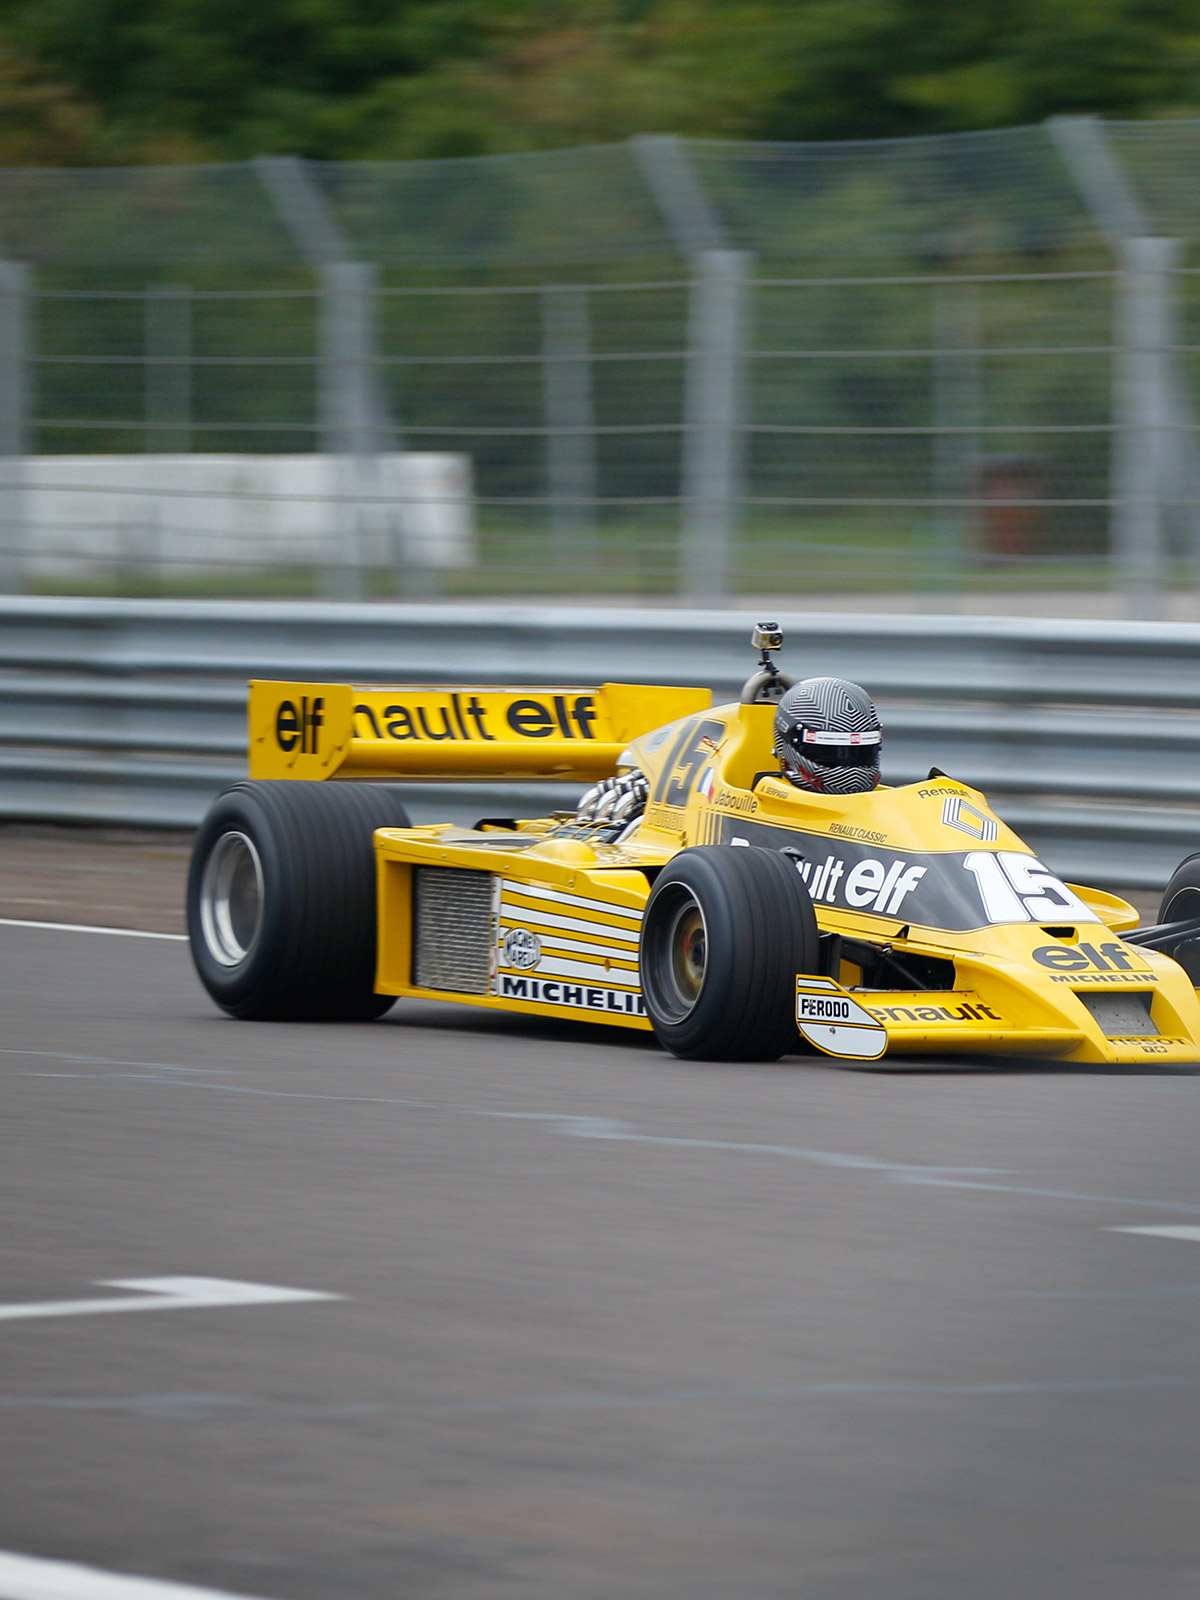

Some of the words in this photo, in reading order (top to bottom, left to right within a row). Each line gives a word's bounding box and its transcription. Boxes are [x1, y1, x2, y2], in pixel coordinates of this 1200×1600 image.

[277, 696, 324, 754] elf
[352, 694, 496, 741] nault
[507, 696, 597, 740] elf
[714, 790, 758, 813] Jabouille
[918, 787, 972, 799] Renault
[829, 823, 859, 838] RENAULT
[857, 828, 888, 843] CLASSIC
[844, 860, 928, 915] elf
[963, 852, 1104, 923] 15
[1032, 943, 1134, 971] elf
[1049, 974, 1160, 983] MICHELIN
[801, 999, 850, 1018] FERODO
